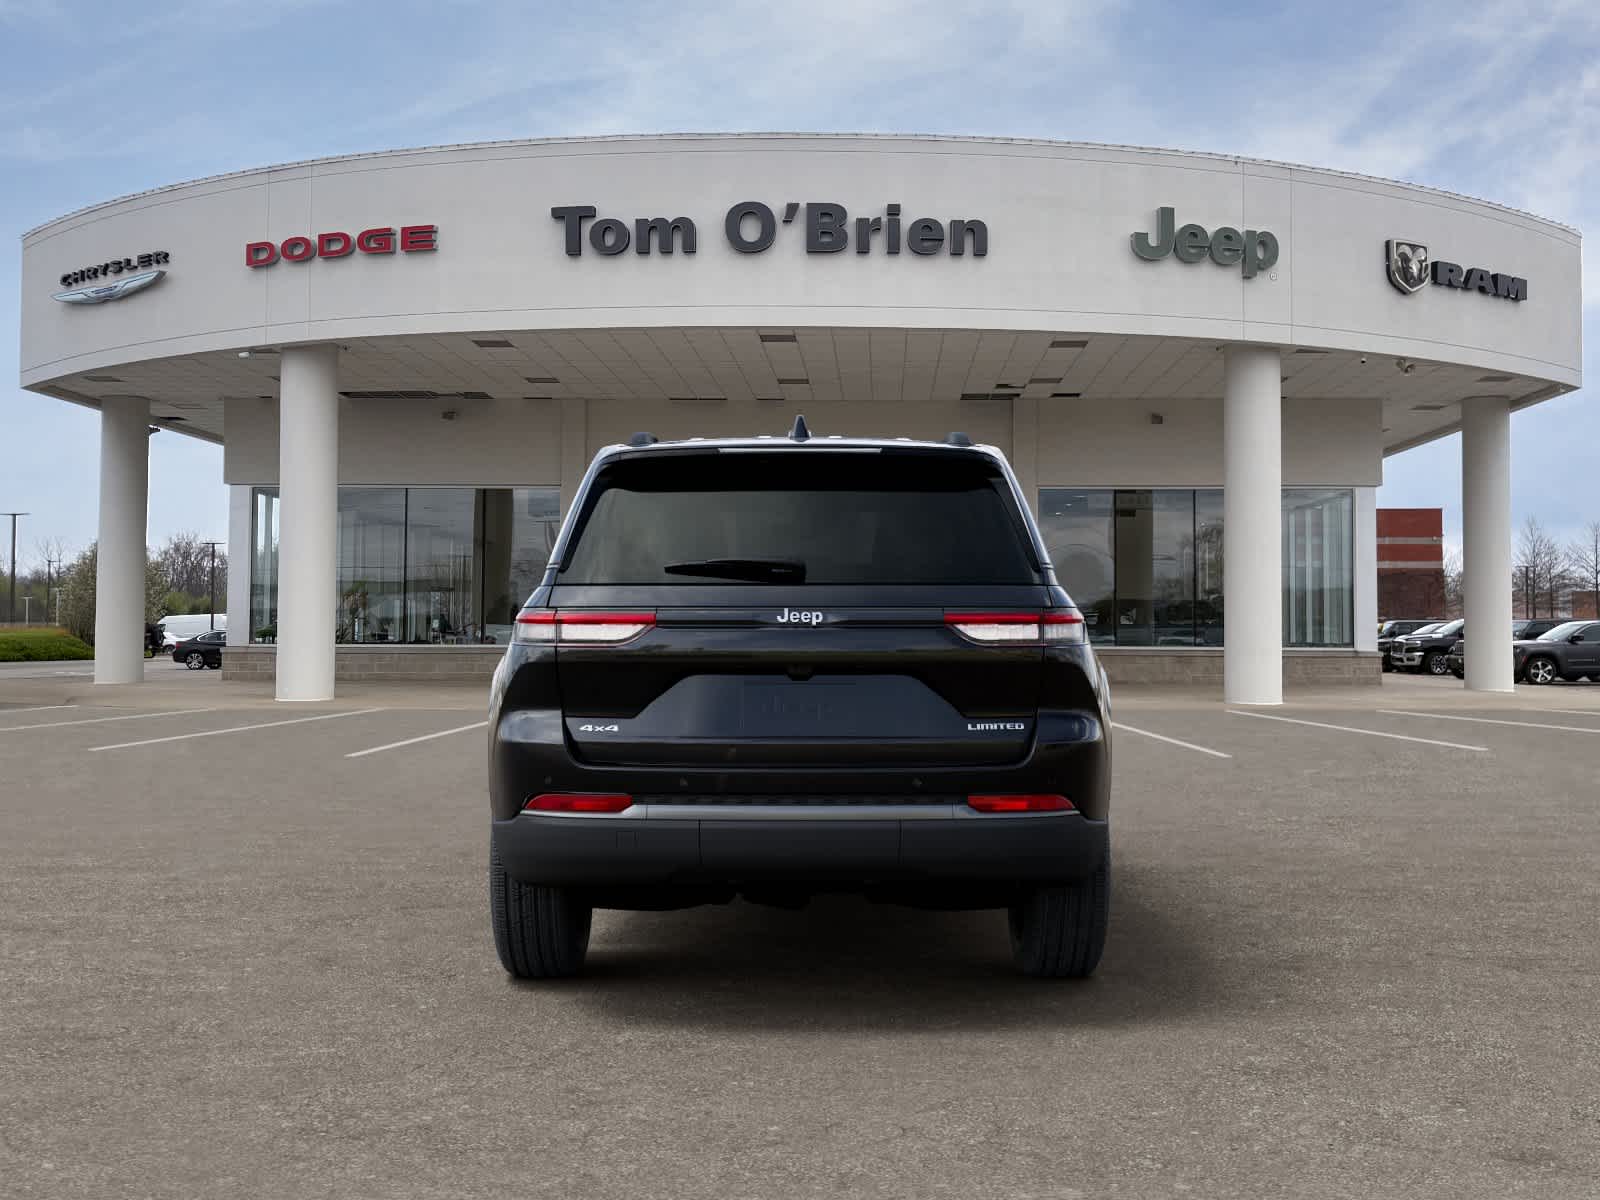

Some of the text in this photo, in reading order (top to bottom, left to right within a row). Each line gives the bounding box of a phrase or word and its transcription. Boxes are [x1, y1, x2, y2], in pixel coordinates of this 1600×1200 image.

[246, 225, 438, 269] DODGE
[551, 201, 988, 256] Tom O'Brien
[1130, 206, 1279, 279] Jeep
[60, 251, 169, 287] CHRYSLER
[1431, 261, 1528, 302] RAM
[776, 607, 824, 626] Jeep
[579, 724, 620, 732] 4x4
[967, 722, 1025, 731] LIMITED
